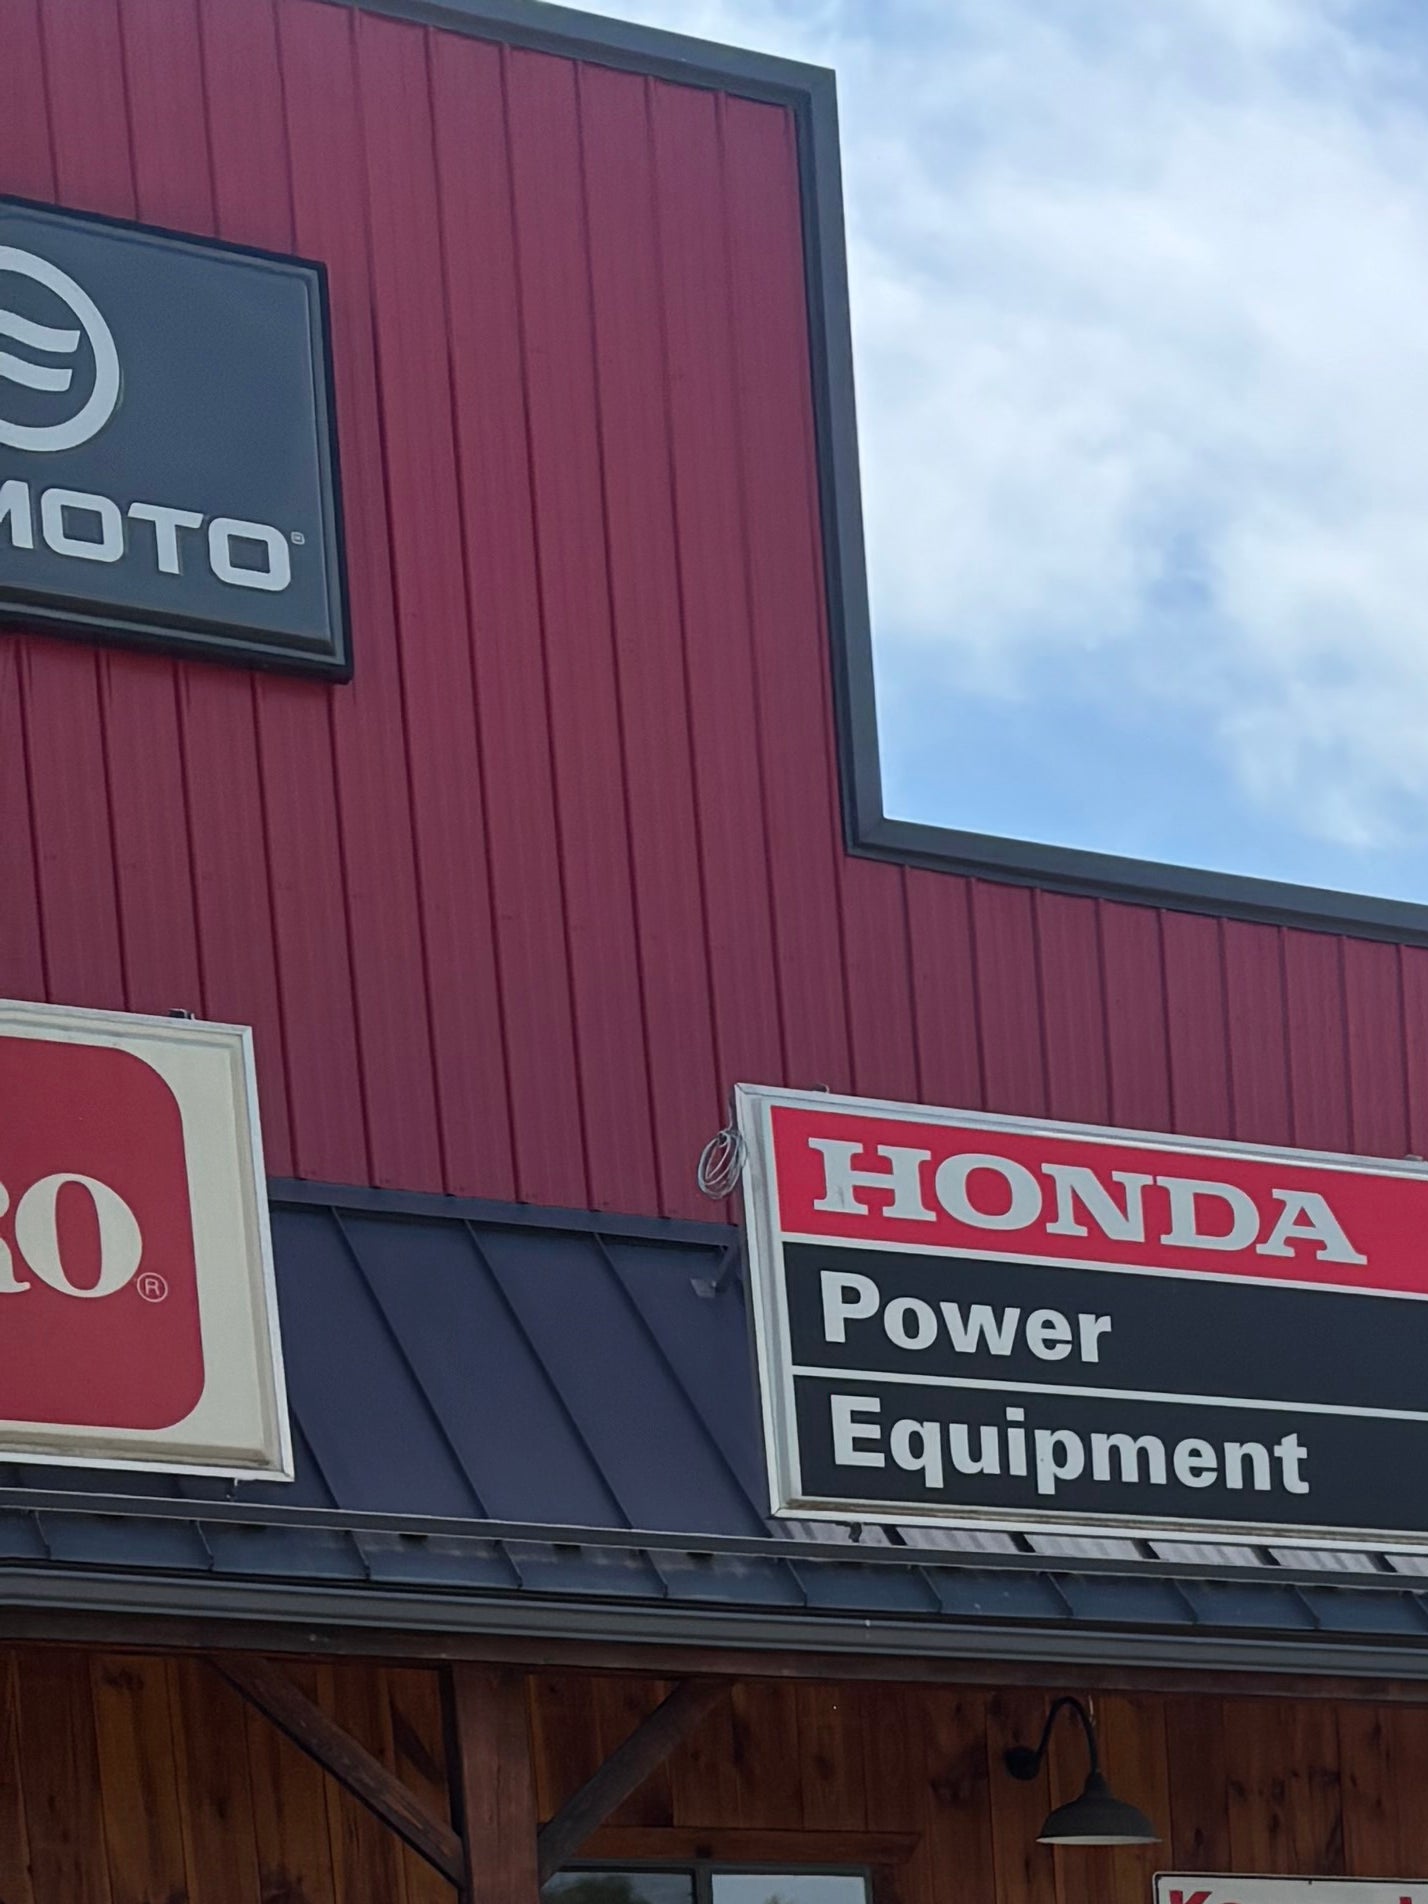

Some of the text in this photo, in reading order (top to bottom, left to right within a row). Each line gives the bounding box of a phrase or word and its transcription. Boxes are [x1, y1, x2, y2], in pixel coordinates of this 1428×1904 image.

[807, 1137, 1368, 1265] HONDA
[819, 1270, 1113, 1364] Power
[829, 1393, 1311, 1496] Equipment
